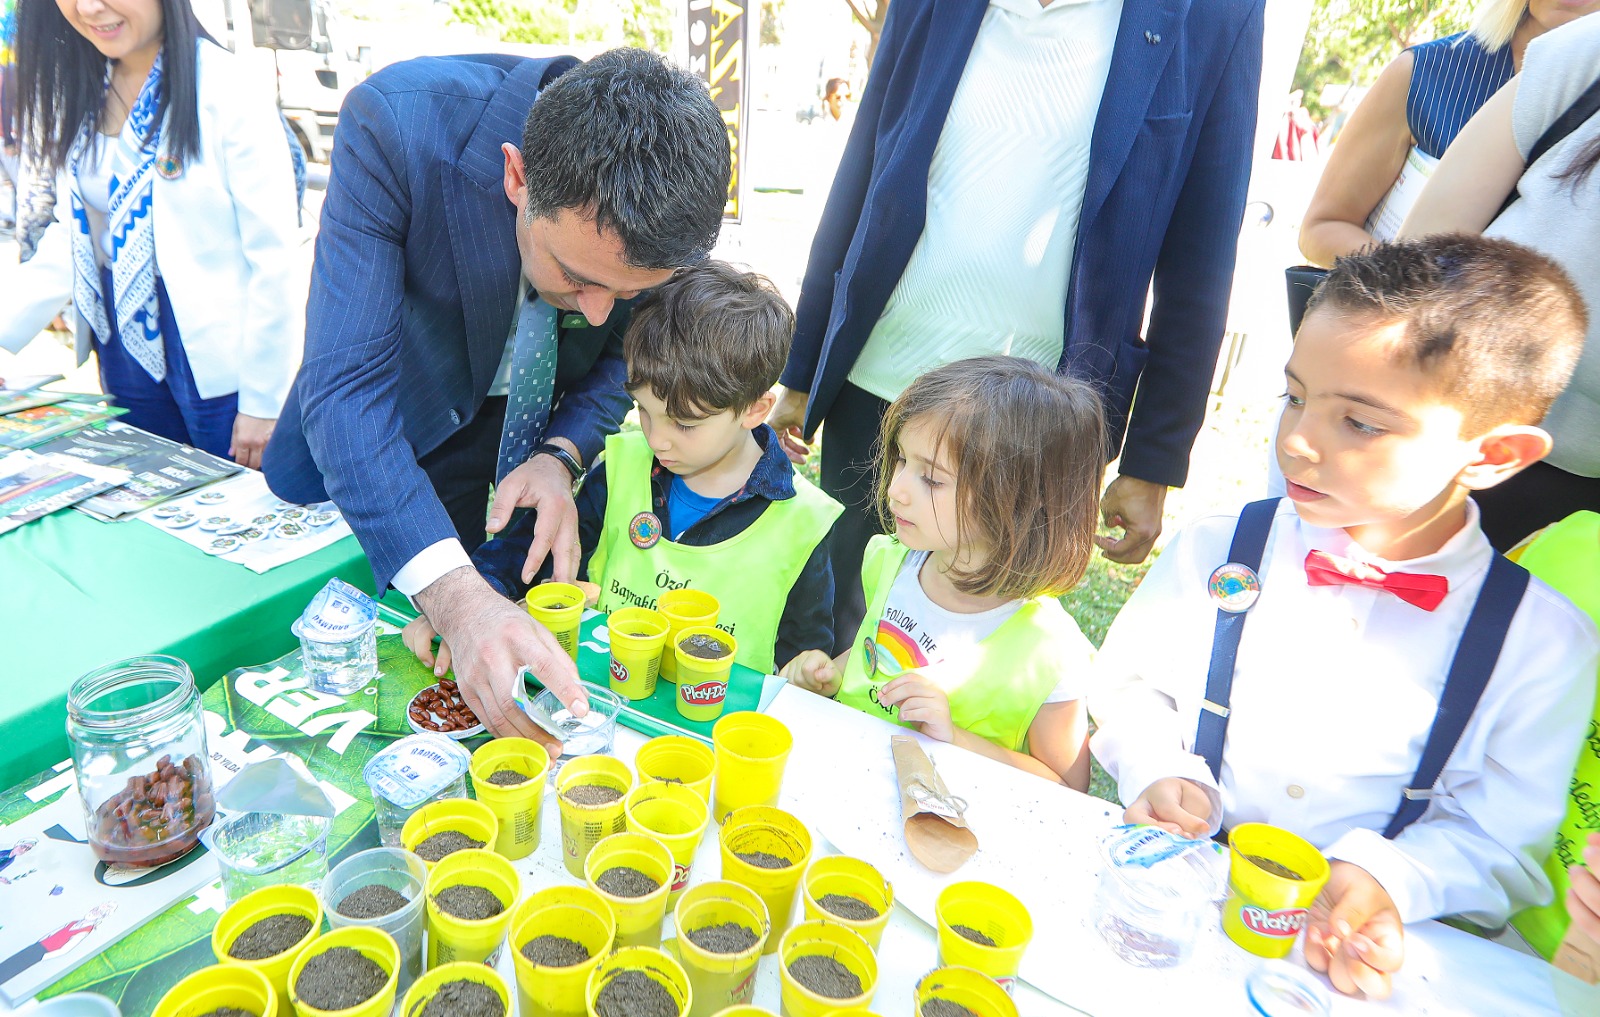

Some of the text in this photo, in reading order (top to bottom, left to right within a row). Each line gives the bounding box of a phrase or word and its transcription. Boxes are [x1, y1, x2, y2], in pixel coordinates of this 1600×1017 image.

[886, 607, 938, 654] FOLLOW THE
[235, 666, 379, 756] VER
[210, 751, 241, 774] 30 YILDA
